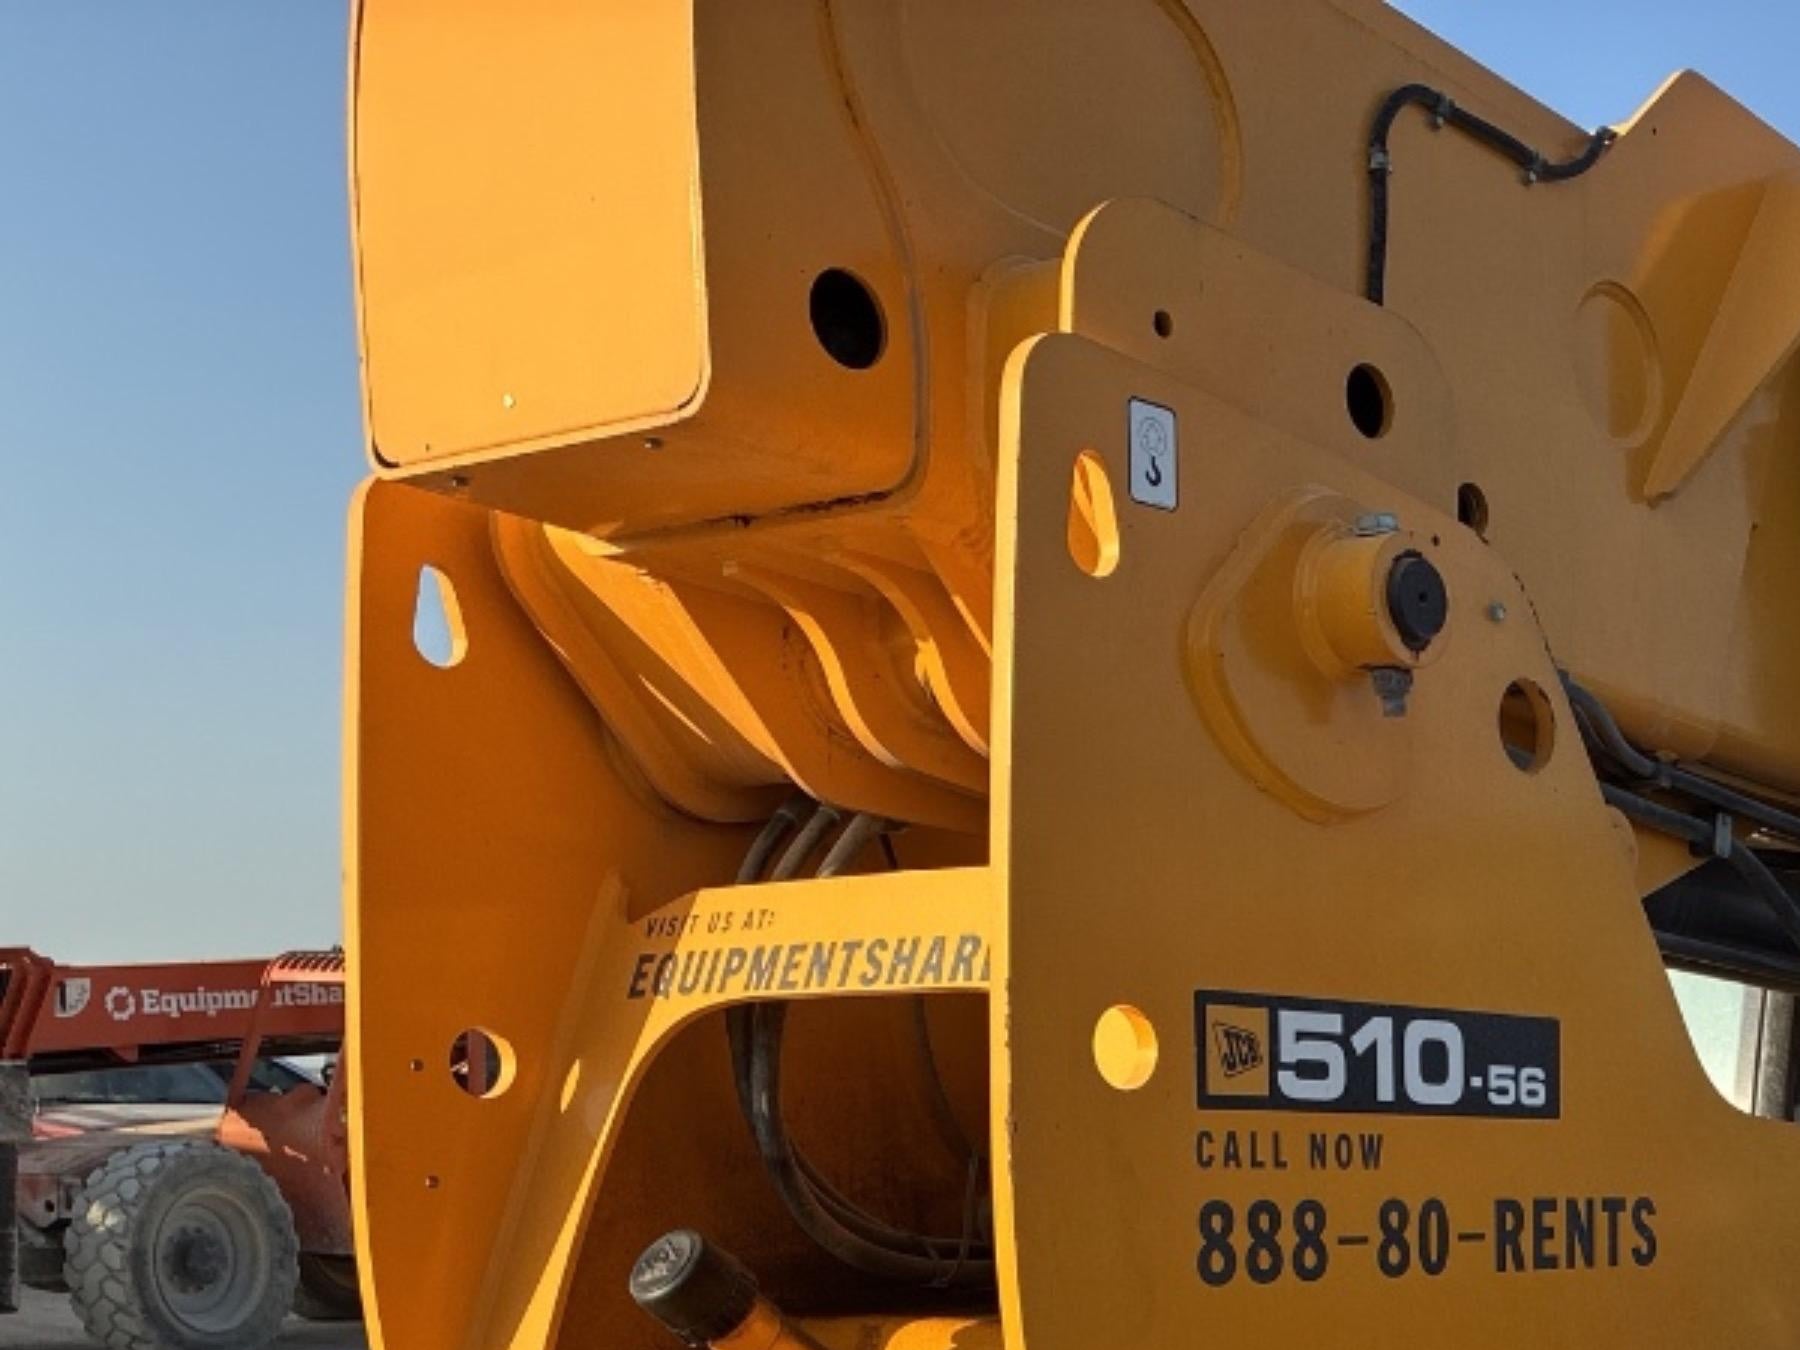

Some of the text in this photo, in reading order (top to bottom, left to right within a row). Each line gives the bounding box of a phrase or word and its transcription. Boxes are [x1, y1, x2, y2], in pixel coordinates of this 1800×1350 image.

[645, 908, 776, 938] VISIT US AT:
[1196, 1130, 1384, 1170] CALL NOW
[1196, 1197, 1658, 1288] 888-80-RENTS
